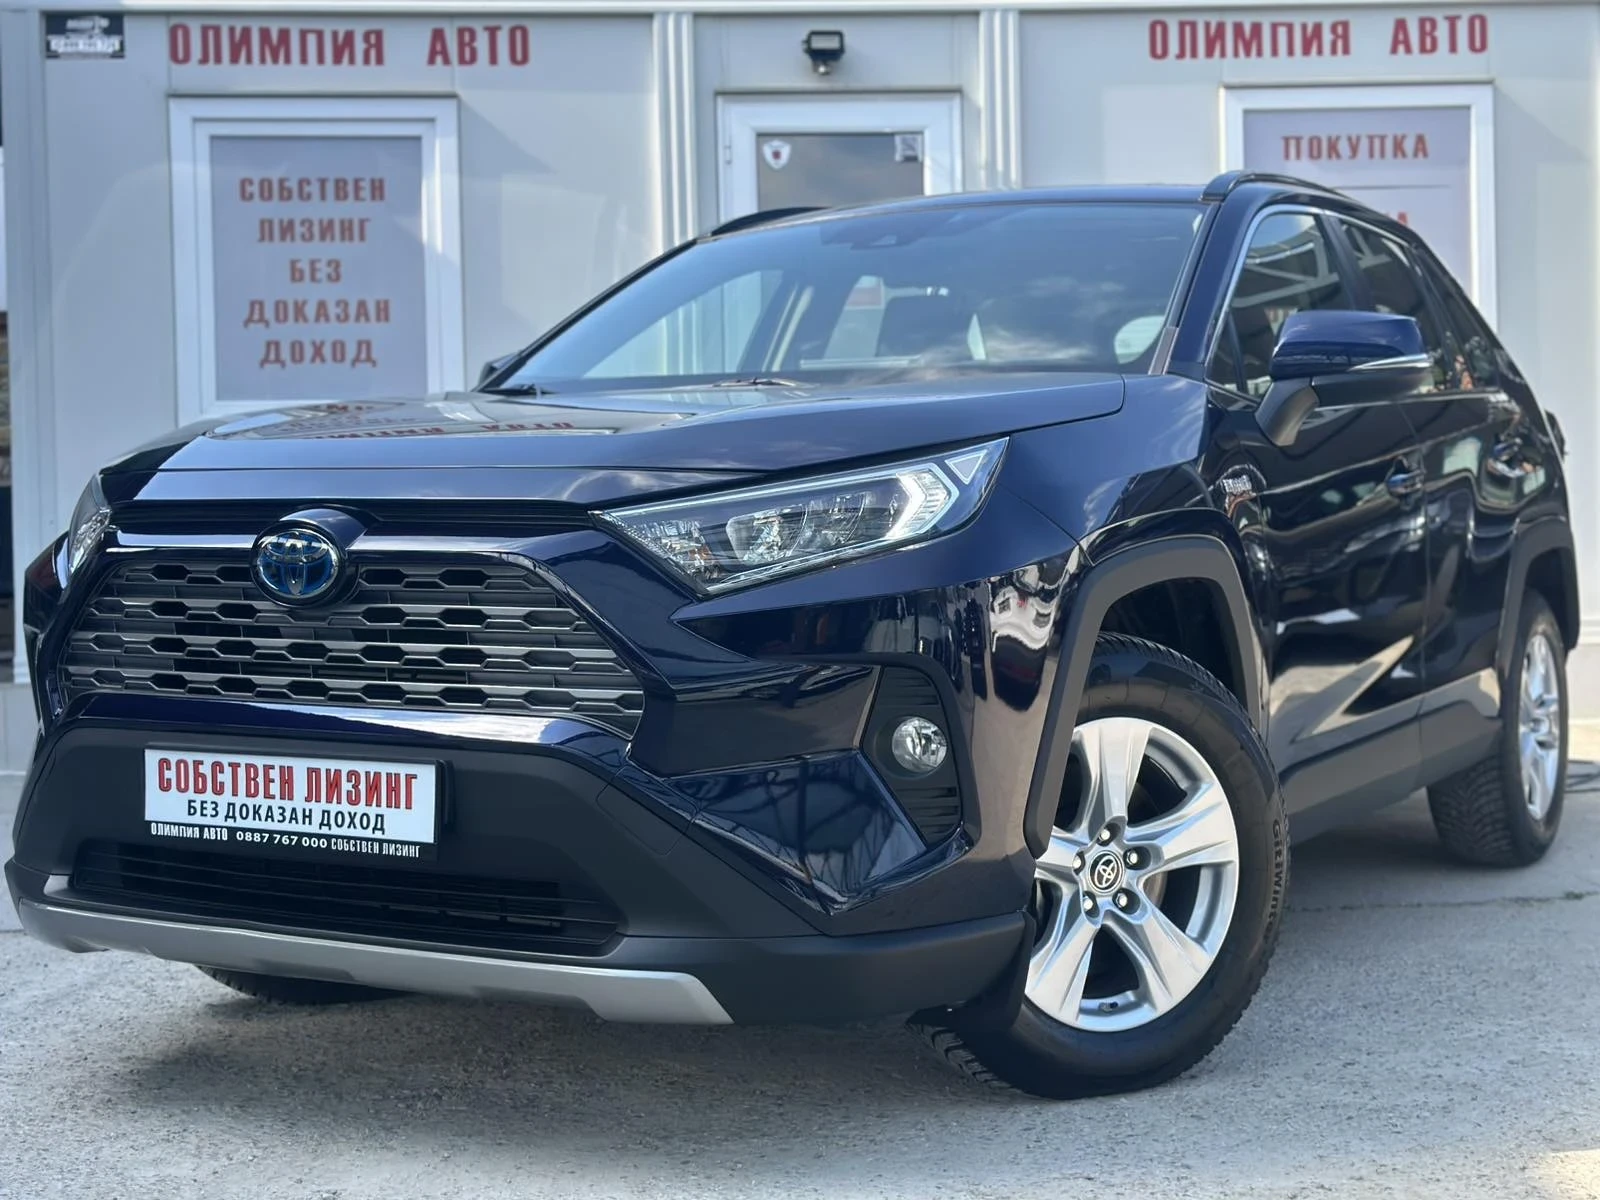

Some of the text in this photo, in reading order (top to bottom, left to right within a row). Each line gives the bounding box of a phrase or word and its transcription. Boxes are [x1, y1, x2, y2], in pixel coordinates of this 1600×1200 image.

[169, 22, 531, 66] ОЛИМПИЯ АВТО
[1149, 14, 1489, 60] ОЛИМПИЯ АВТО
[1282, 133, 1430, 162] ПОКУПКА
[239, 177, 386, 202] СОБСТВЕН
[257, 217, 372, 243] ЛИЗИНГ
[289, 259, 342, 283] БЕЗ
[244, 298, 391, 328] ДОКАЗАН
[260, 340, 378, 368] ДОХОД
[157, 757, 418, 811] СОБСТВЕН ЛИЗИНГ
[187, 799, 386, 835] БЕЗ ДОКАЗАН ДОХОД
[151, 822, 420, 858] ОЛИМПИЯ АВТО 0887 767 000 СОБСТВЕН ЛИЗИНГ
